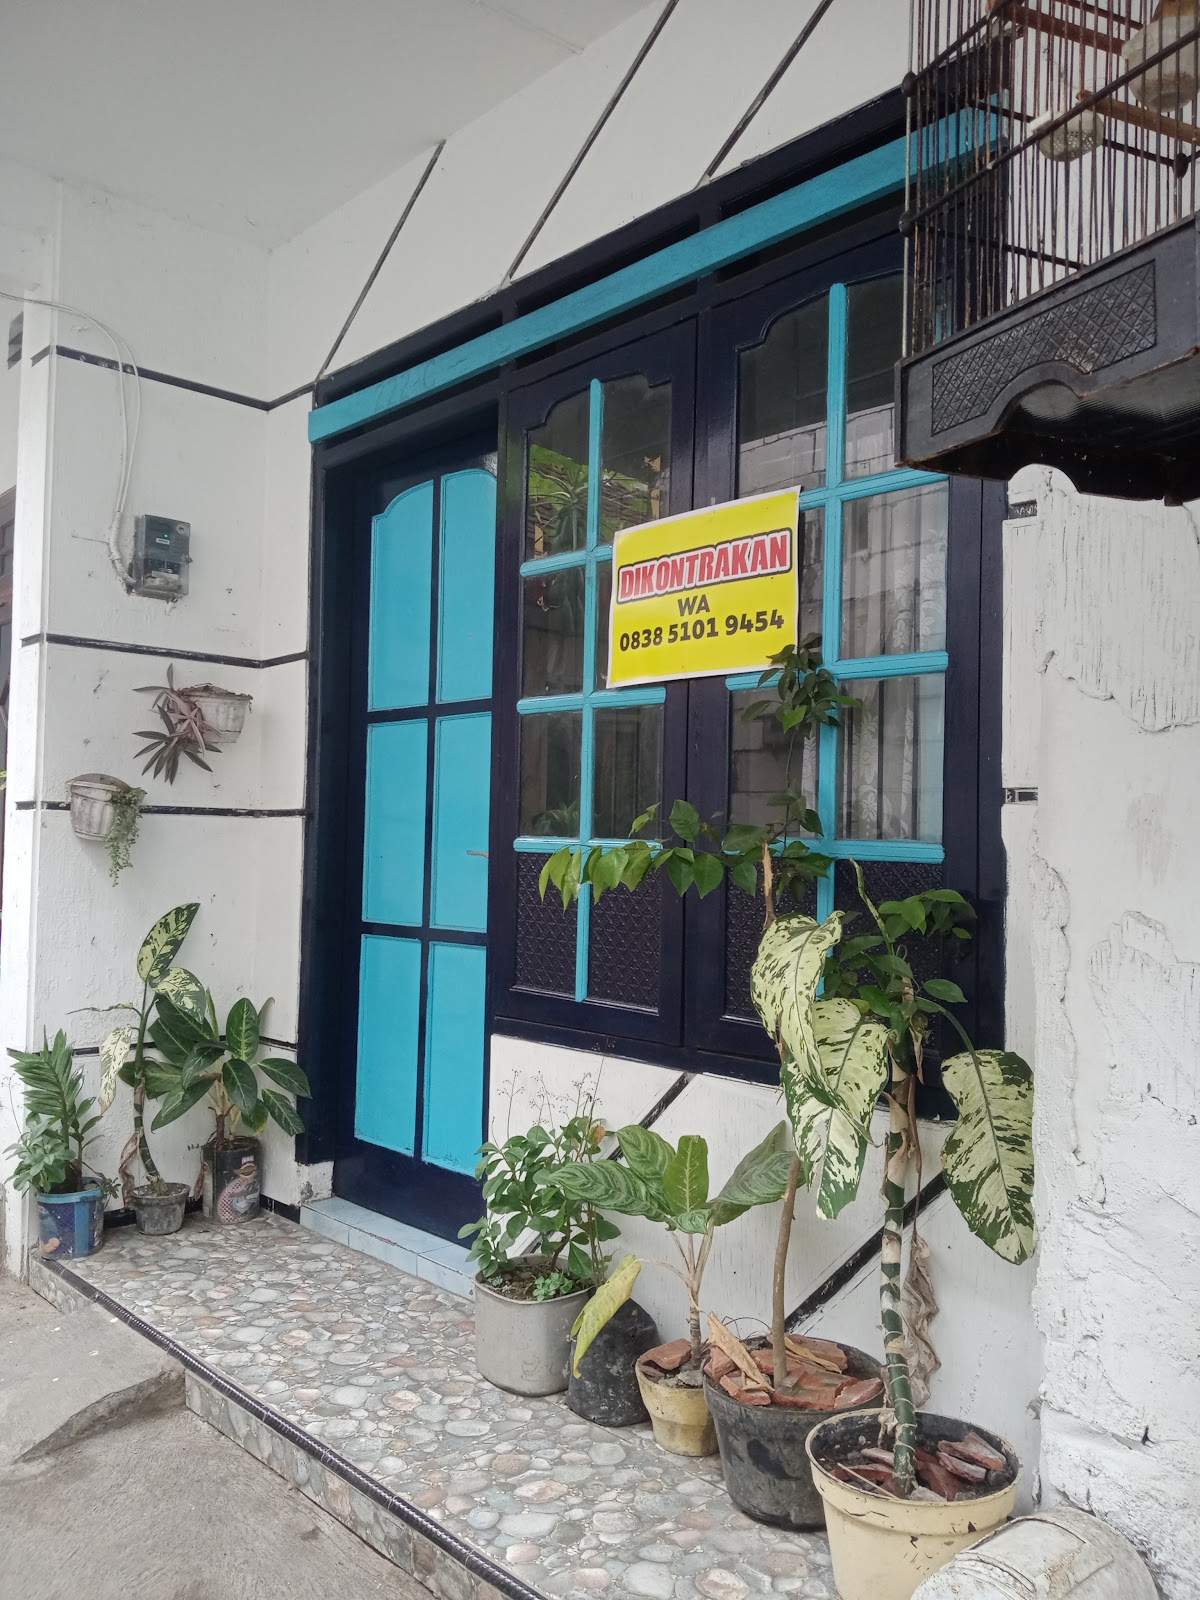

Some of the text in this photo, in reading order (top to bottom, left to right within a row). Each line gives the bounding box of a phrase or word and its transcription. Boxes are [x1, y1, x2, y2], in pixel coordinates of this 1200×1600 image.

[619, 533, 789, 600] DIKONTRAKAN
[678, 594, 710, 617] WA
[619, 609, 785, 651] 0838 5101 9454
